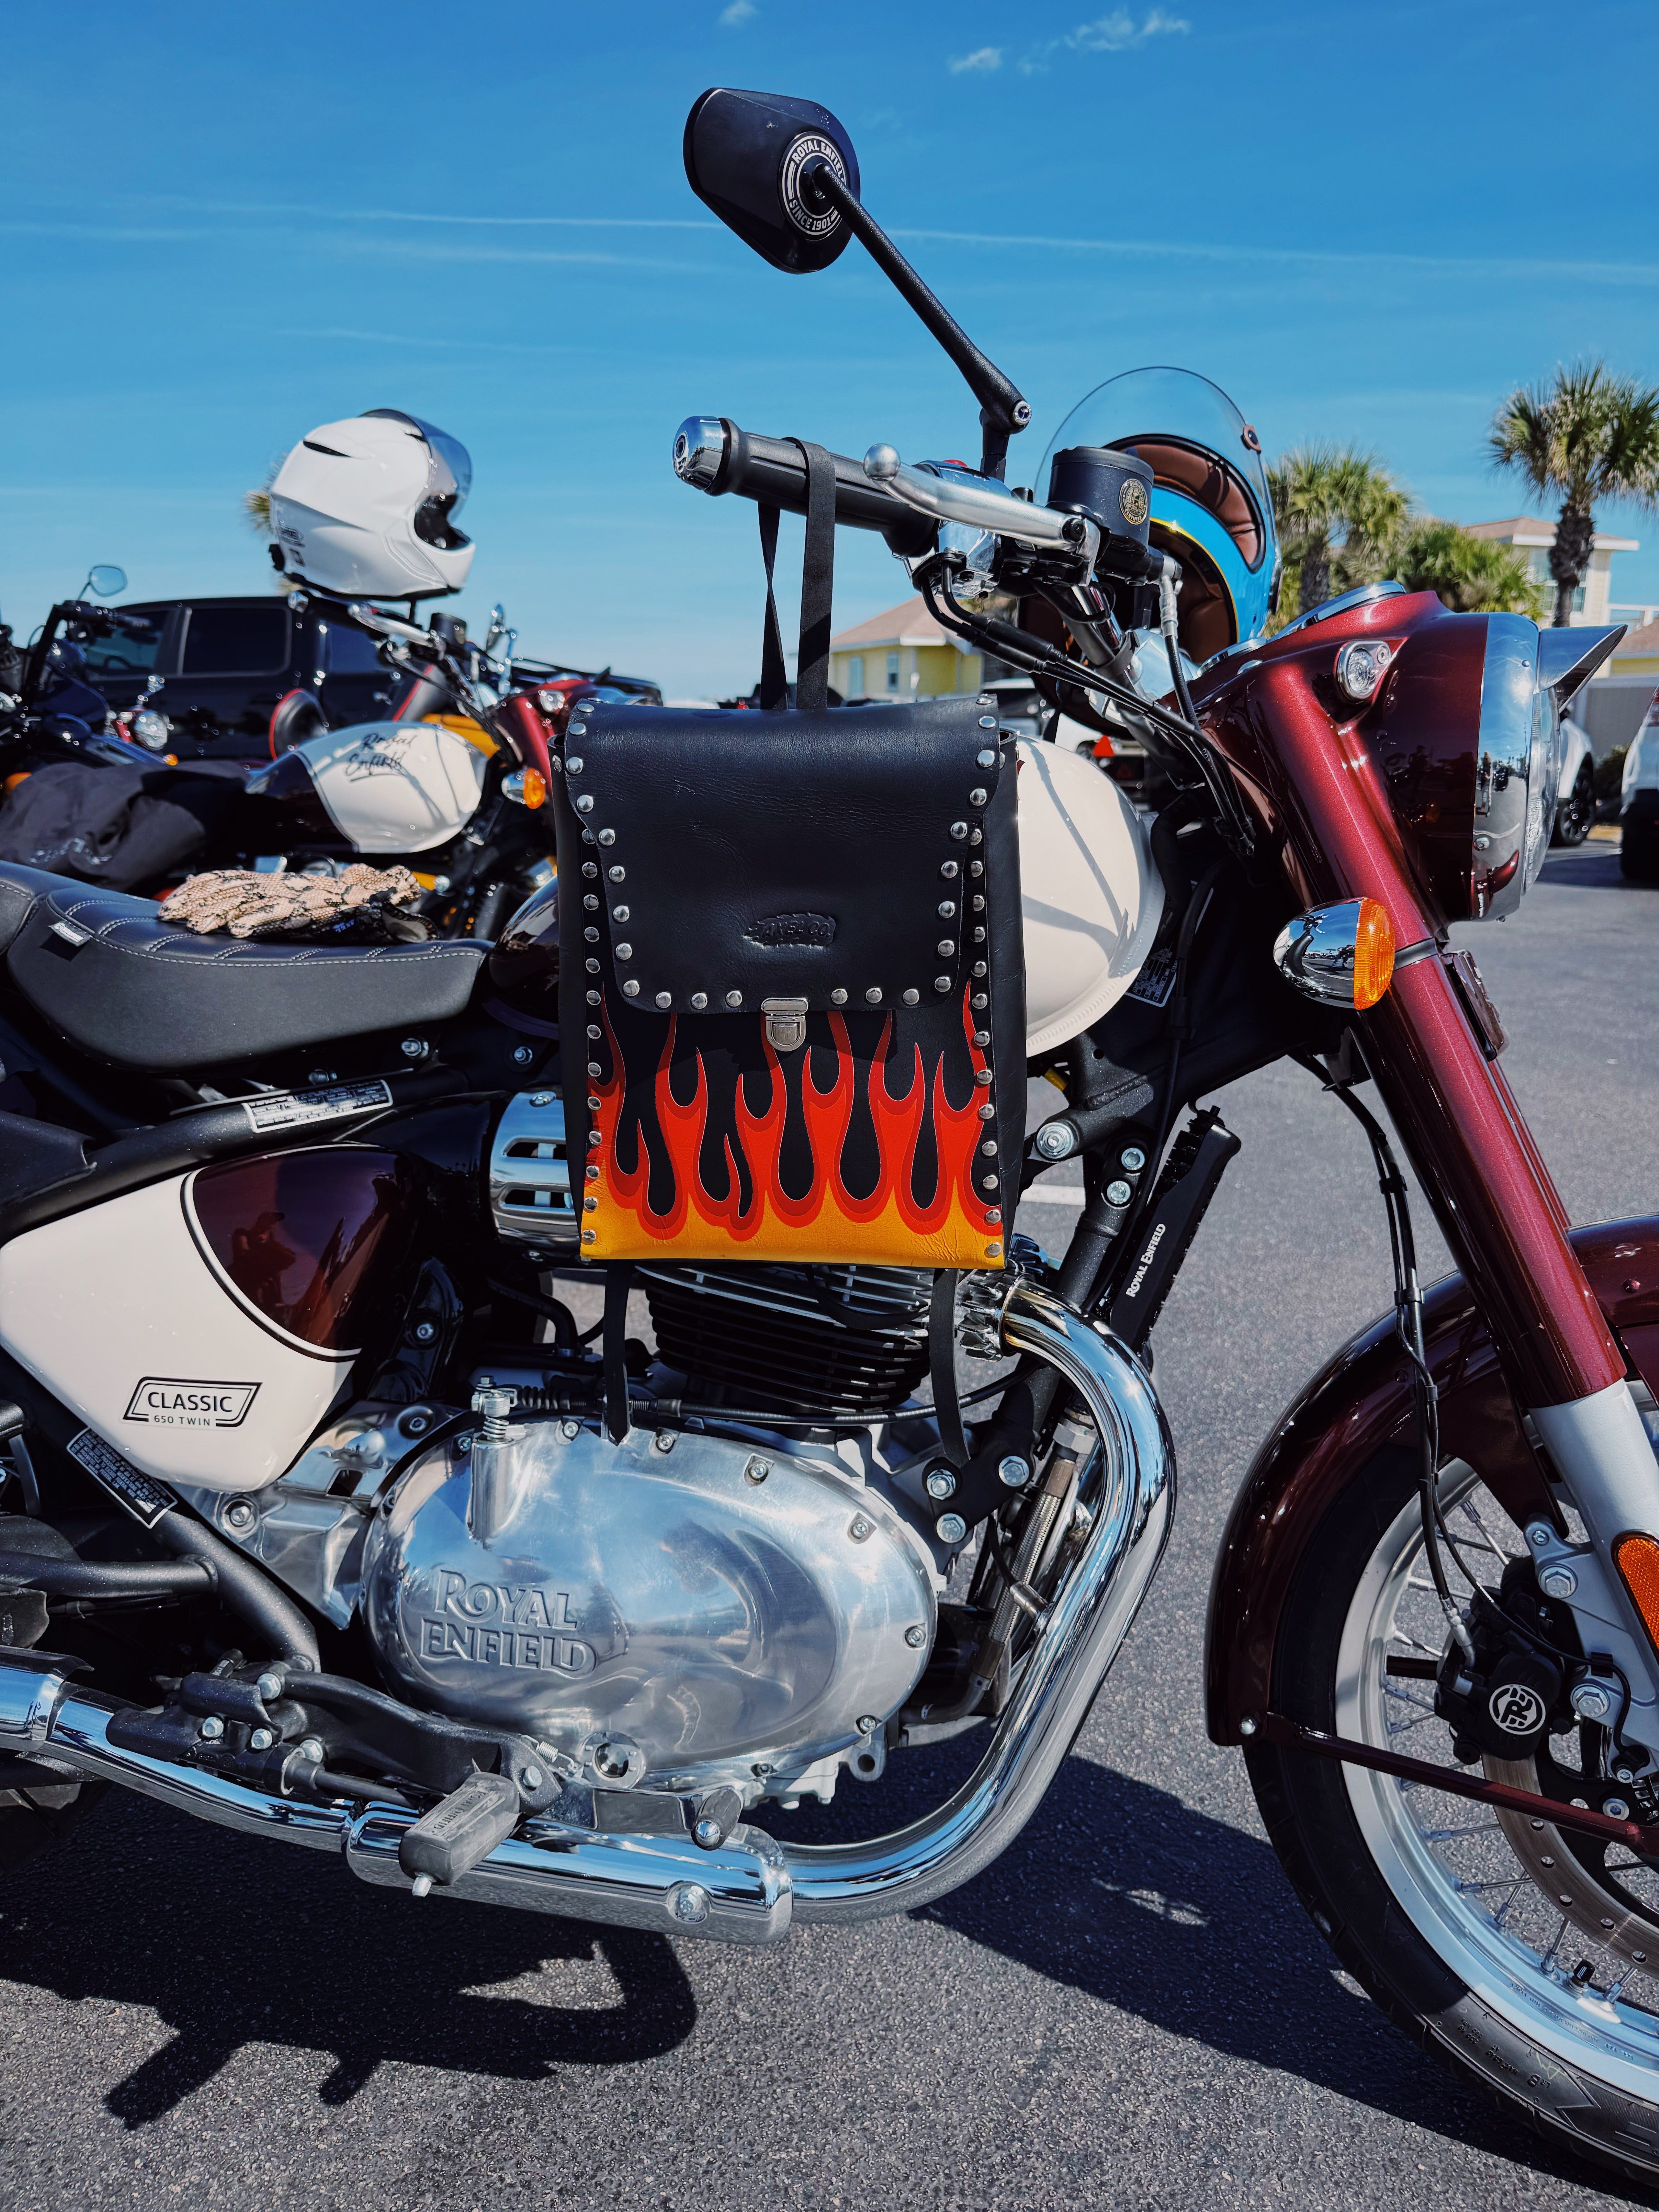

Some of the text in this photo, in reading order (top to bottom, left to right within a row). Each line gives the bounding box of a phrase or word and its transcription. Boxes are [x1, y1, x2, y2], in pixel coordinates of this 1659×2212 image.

[792, 140, 844, 183] ROYAL ENFIEL
[789, 199, 831, 231] SINCE 1901
[1125, 1223, 1166, 1298] ROYAL ENFIELD
[148, 1392, 232, 1412] CLASSIC
[154, 1415, 210, 1426] 650 TWIN
[434, 1569, 579, 1630] ROYAL
[420, 1618, 598, 1680] ENFIELD
